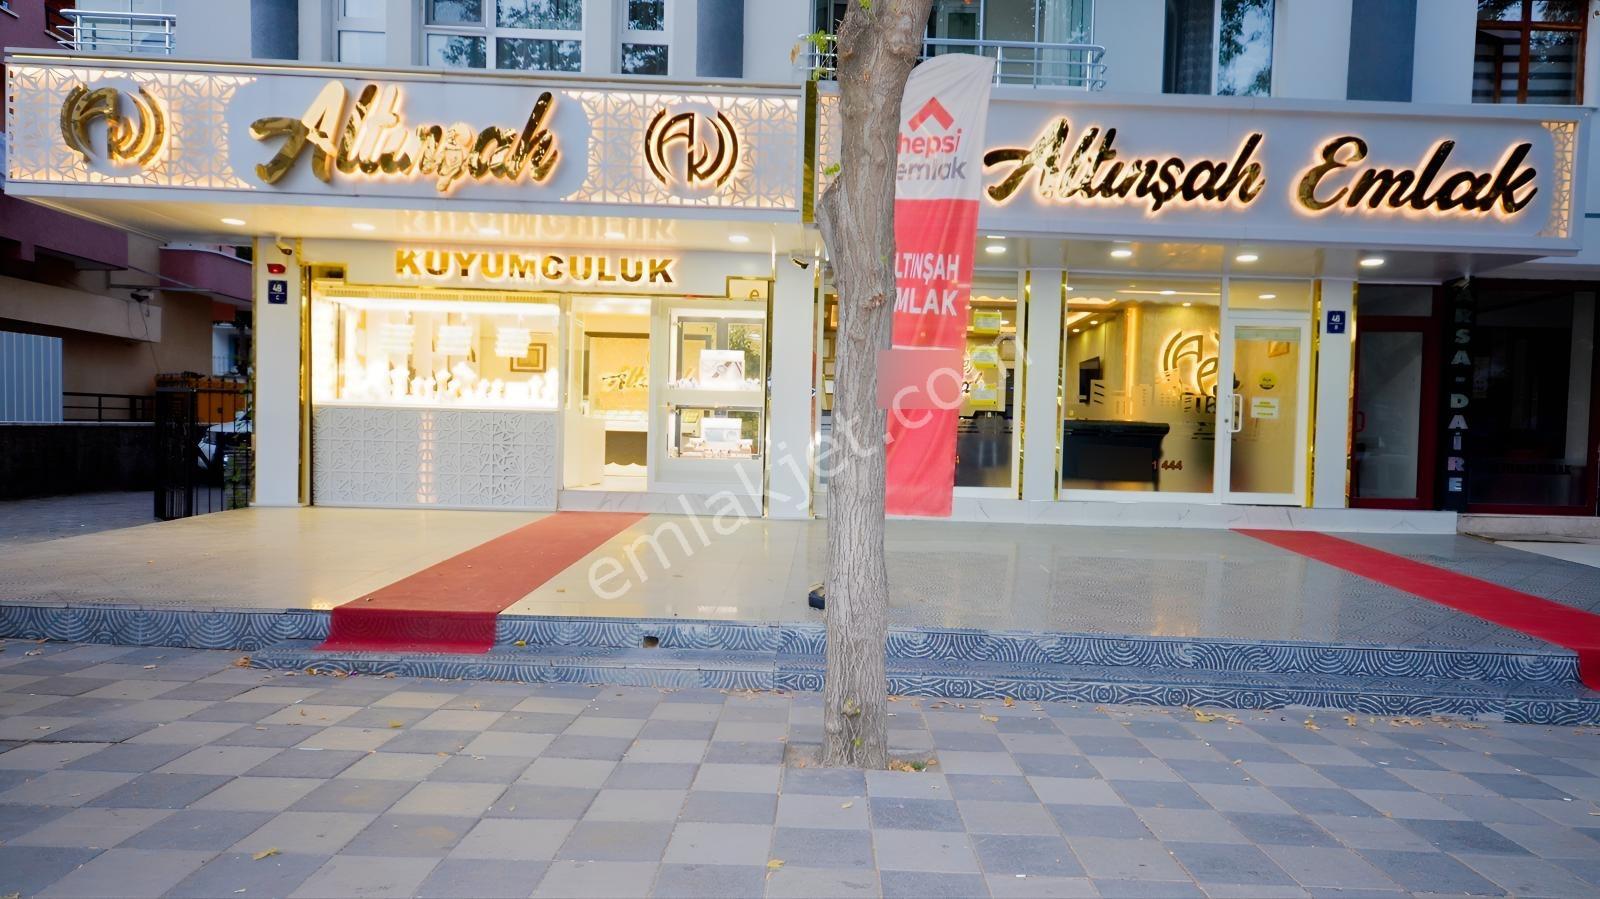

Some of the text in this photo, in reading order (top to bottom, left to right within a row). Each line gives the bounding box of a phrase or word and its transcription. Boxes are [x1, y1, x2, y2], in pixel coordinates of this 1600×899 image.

[896, 128, 962, 158] hepsi
[897, 156, 967, 181] emlak
[1299, 136, 1539, 214] Emlak
[395, 249, 674, 283] KUYUMCULUK
[895, 252, 960, 286] LTINŞAH
[894, 287, 959, 317] MLAK
